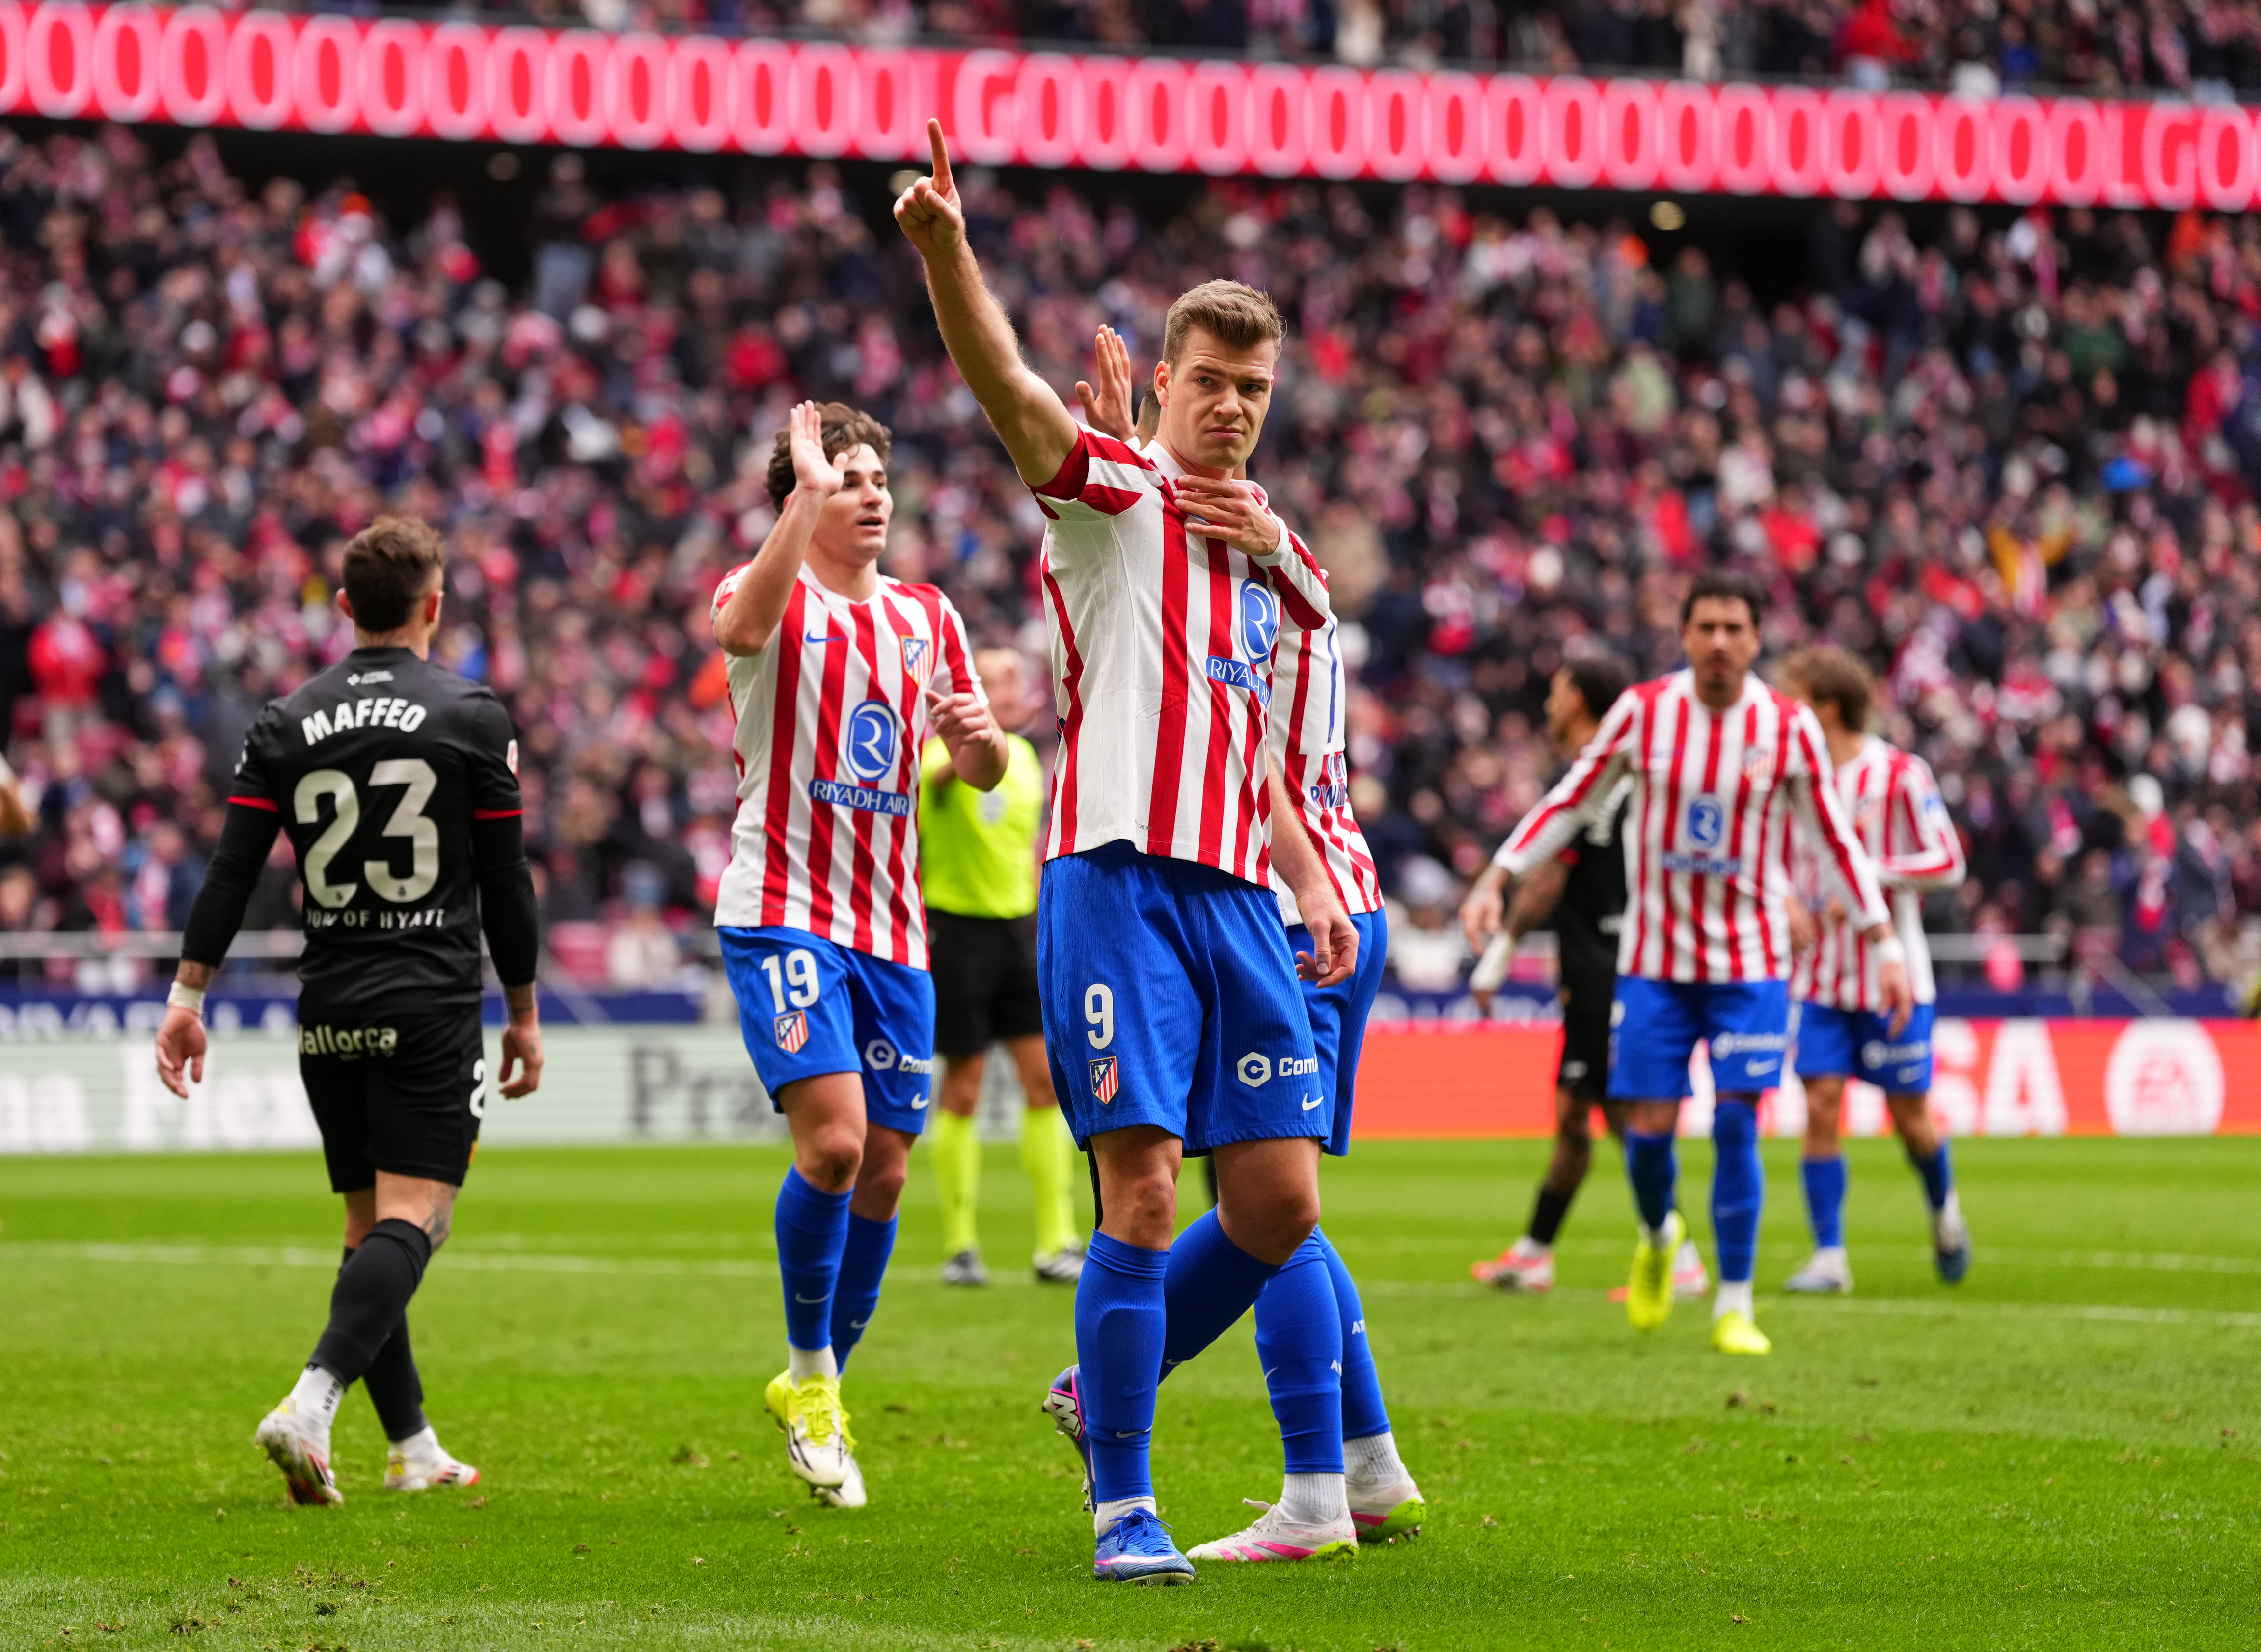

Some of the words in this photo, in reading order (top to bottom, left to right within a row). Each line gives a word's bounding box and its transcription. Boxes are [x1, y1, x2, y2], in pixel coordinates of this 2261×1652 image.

[301, 697, 428, 745] MAFFEO
[813, 781, 882, 810] RIYADH
[884, 795, 908, 815] AIR
[294, 758, 439, 908] 23
[343, 909, 370, 928] OF
[379, 908, 445, 929] HYATT
[761, 949, 820, 1014] 19
[298, 1023, 398, 1055] allorca
[1085, 983, 1114, 1050] 9
